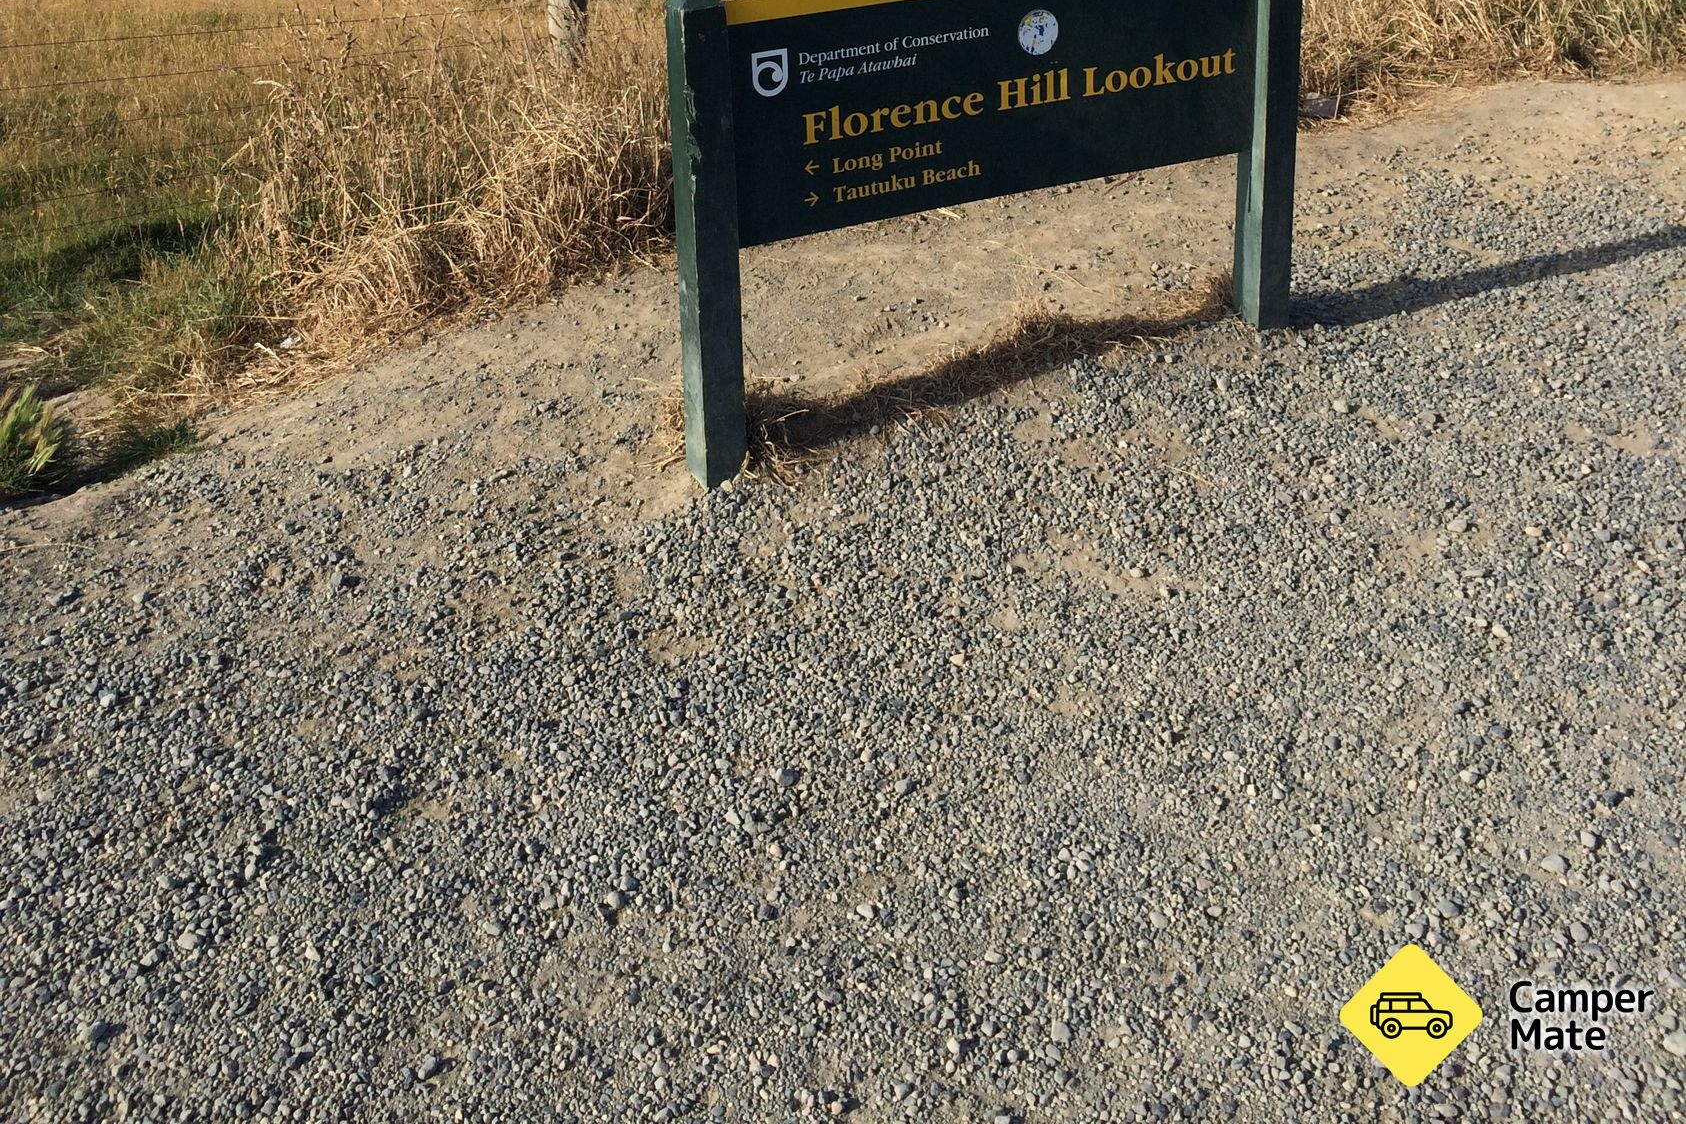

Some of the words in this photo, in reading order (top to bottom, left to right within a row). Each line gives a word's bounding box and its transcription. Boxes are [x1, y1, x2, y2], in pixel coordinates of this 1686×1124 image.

[798, 42, 881, 66] Department
[884, 37, 899, 51] of
[902, 26, 989, 48] Conservation
[799, 70, 815, 84] Te
[818, 65, 854, 82] Papa
[857, 53, 918, 74] Atawhai
[801, 92, 985, 146] Florence
[997, 68, 1071, 111] Hill
[1082, 48, 1237, 98] Lookout
[832, 152, 884, 174] Long
[888, 139, 943, 163] Point
[832, 174, 916, 203] Tautuku
[922, 160, 982, 185] Beach
